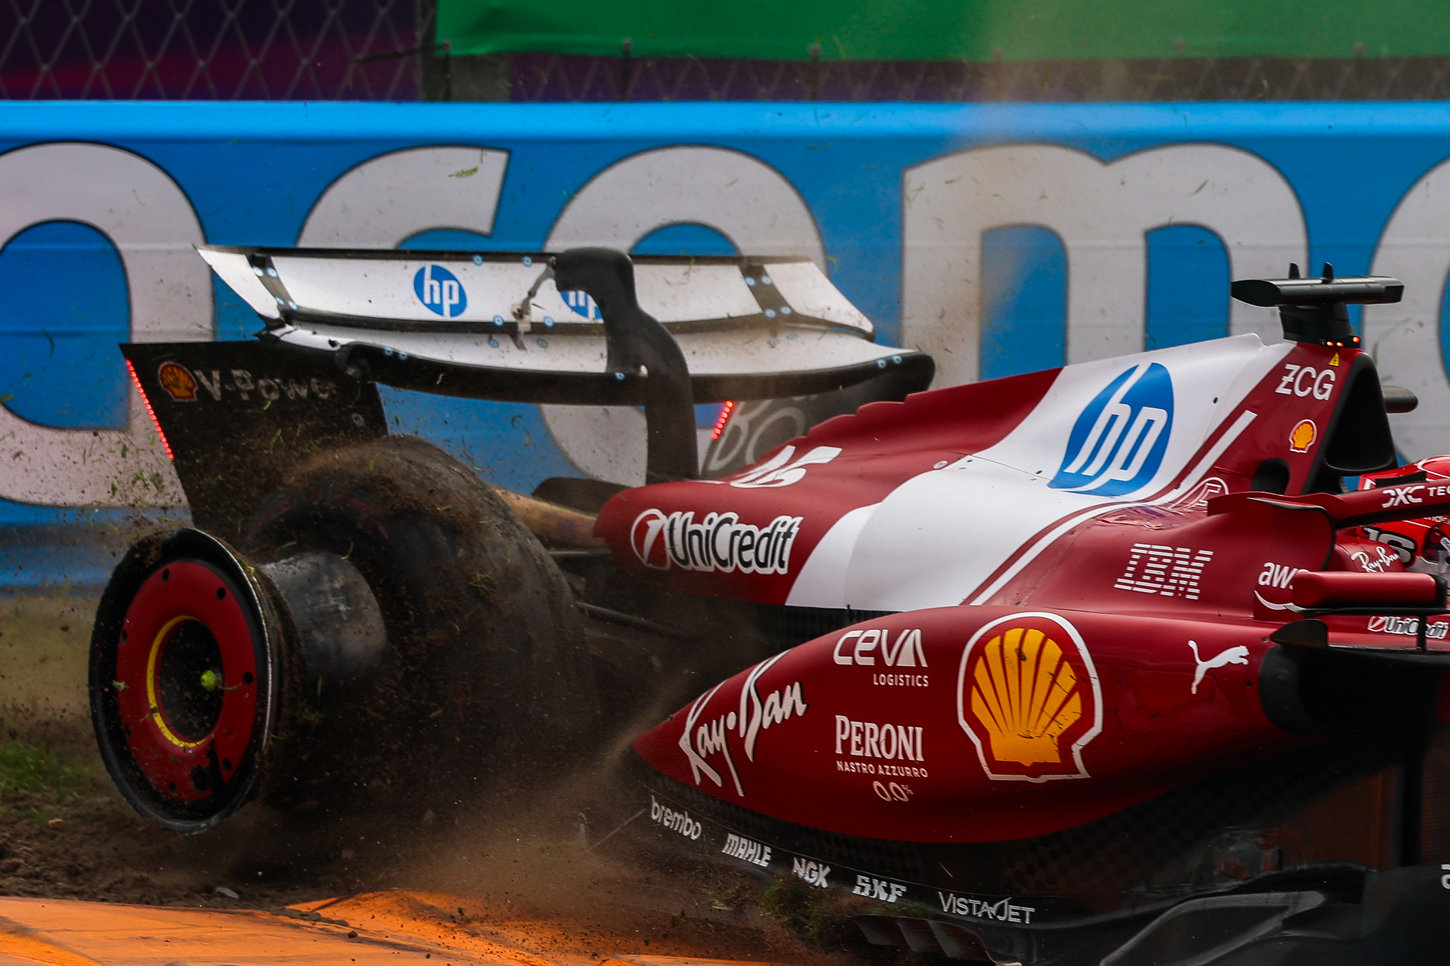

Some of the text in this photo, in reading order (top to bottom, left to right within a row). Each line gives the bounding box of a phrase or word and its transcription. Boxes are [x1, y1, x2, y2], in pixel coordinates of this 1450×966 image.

[417, 264, 465, 318] hp
[1056, 361, 1170, 495] hp
[667, 511, 804, 575] UniCredit
[1113, 542, 1215, 600] IBM
[1384, 616, 1450, 639] UniCdit
[872, 673, 930, 688] LOGISTICS
[834, 714, 925, 762] PERONI
[835, 760, 929, 778] NASTRO AZZURRO
[650, 795, 702, 842] brembo
[721, 832, 773, 868] MAHLE
[792, 856, 832, 889] NGK
[852, 874, 908, 904] SKF
